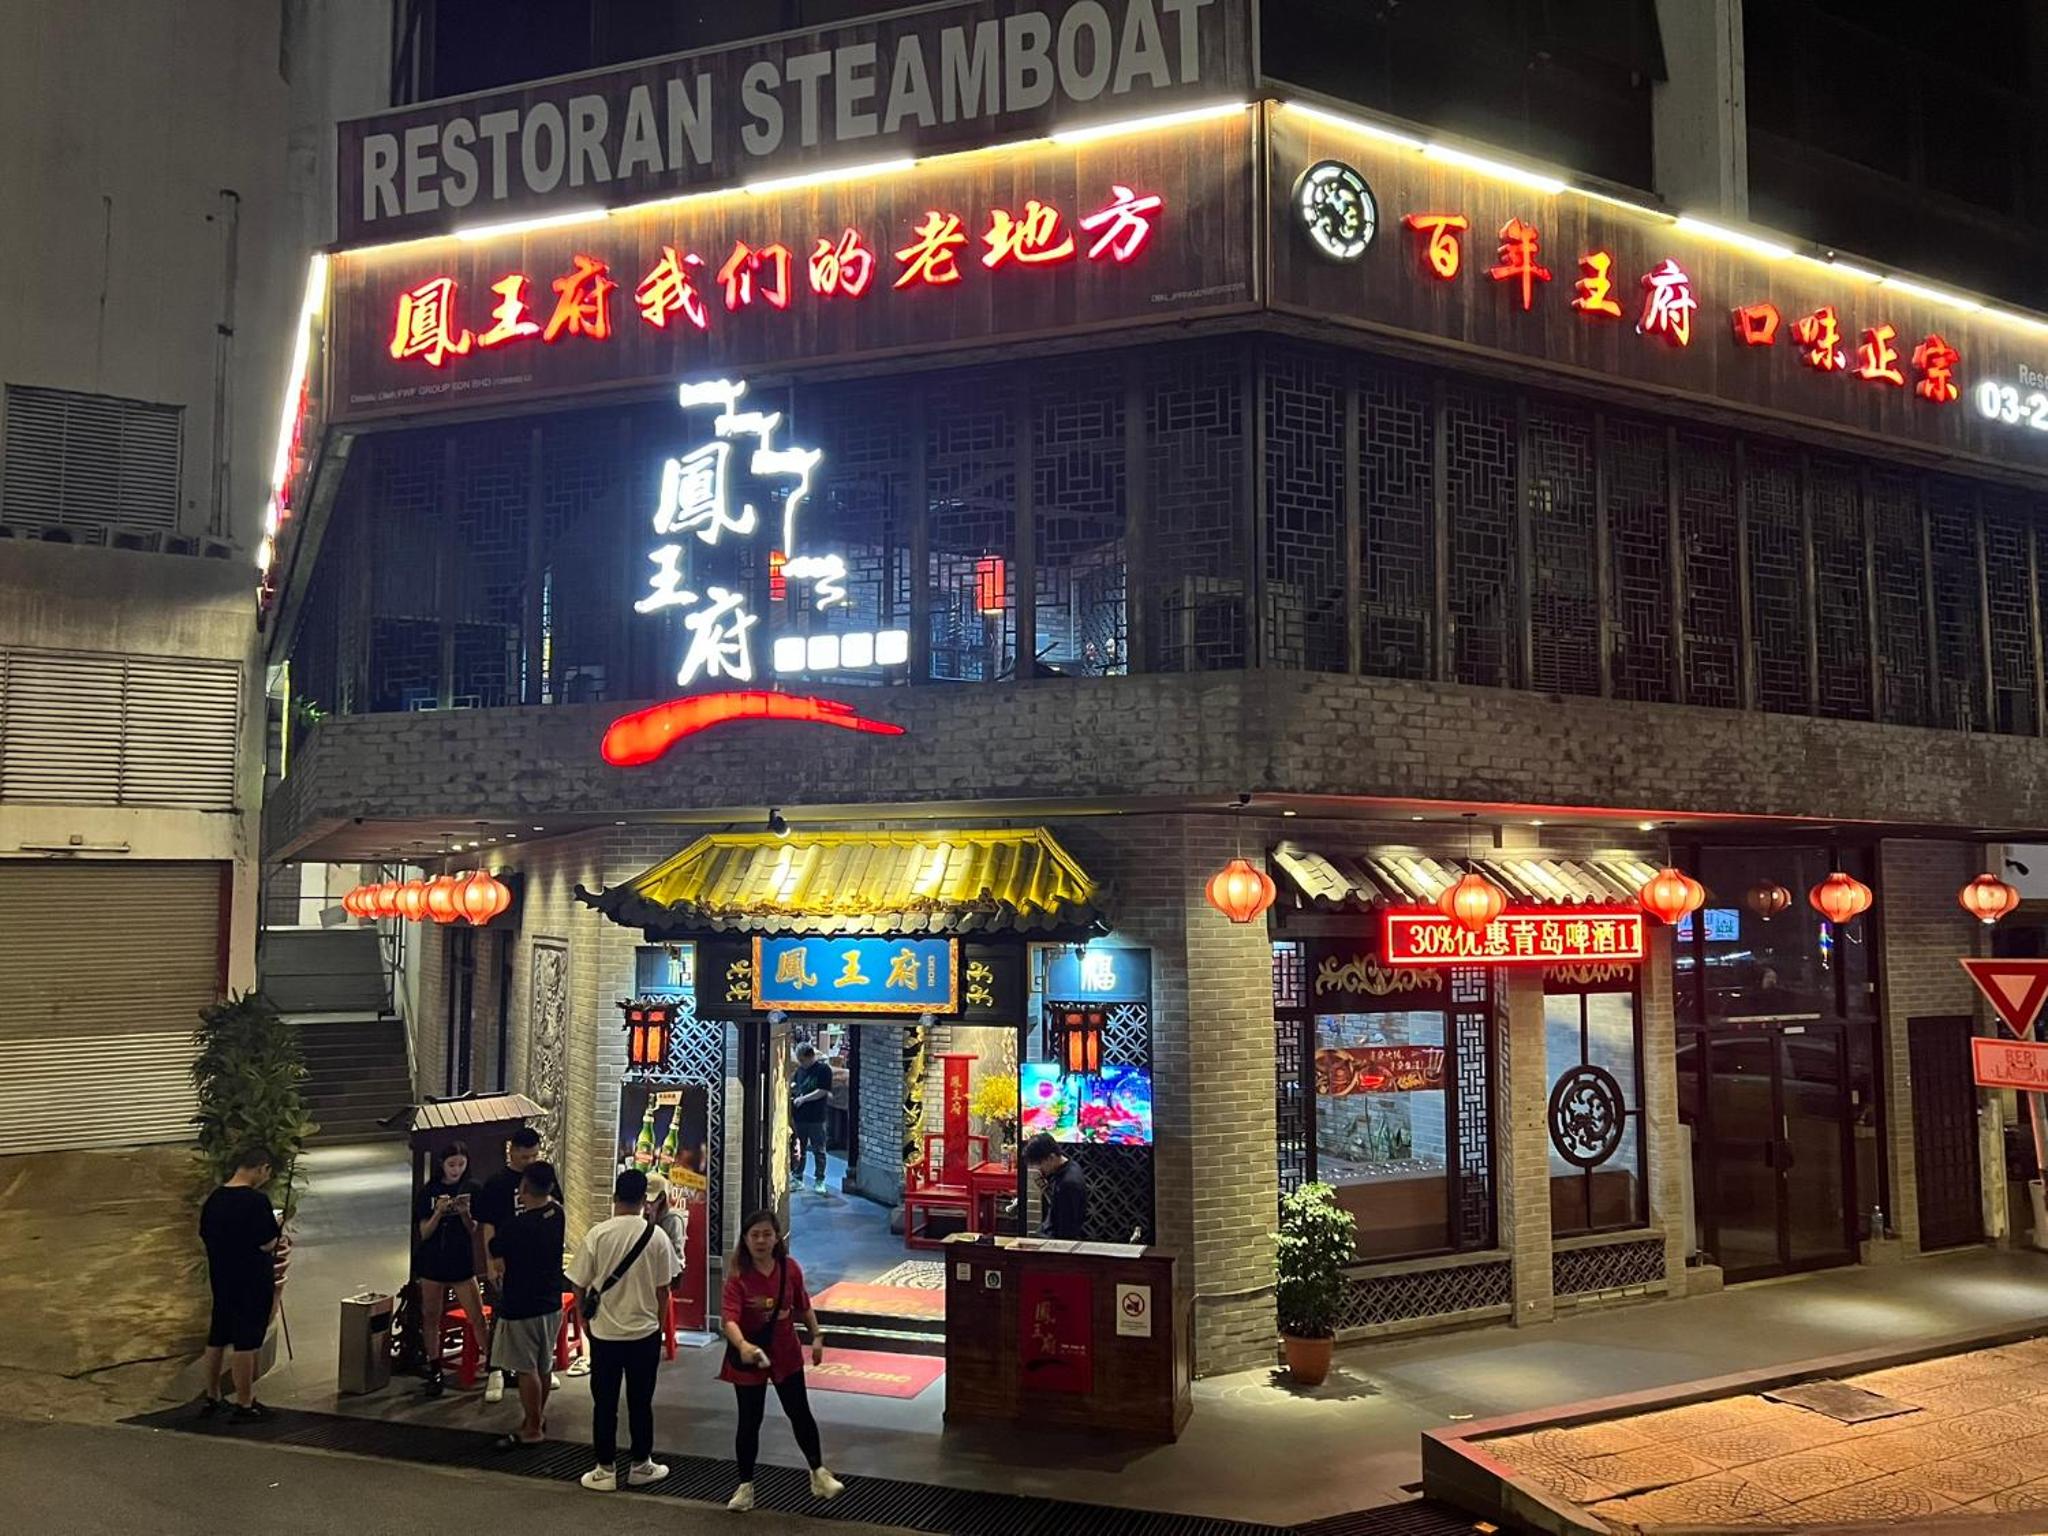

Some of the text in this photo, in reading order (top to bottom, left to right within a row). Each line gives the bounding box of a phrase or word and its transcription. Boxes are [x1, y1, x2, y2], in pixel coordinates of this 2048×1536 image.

[363, 0, 1214, 222] RESTORAN STEAMBOAT
[389, 184, 1164, 368] 鳳王府我们的老地方
[1403, 213, 1961, 403] 百年王府 口味正宗
[633, 441, 758, 687] 鳳王府
[775, 946, 921, 992] 鳳王府
